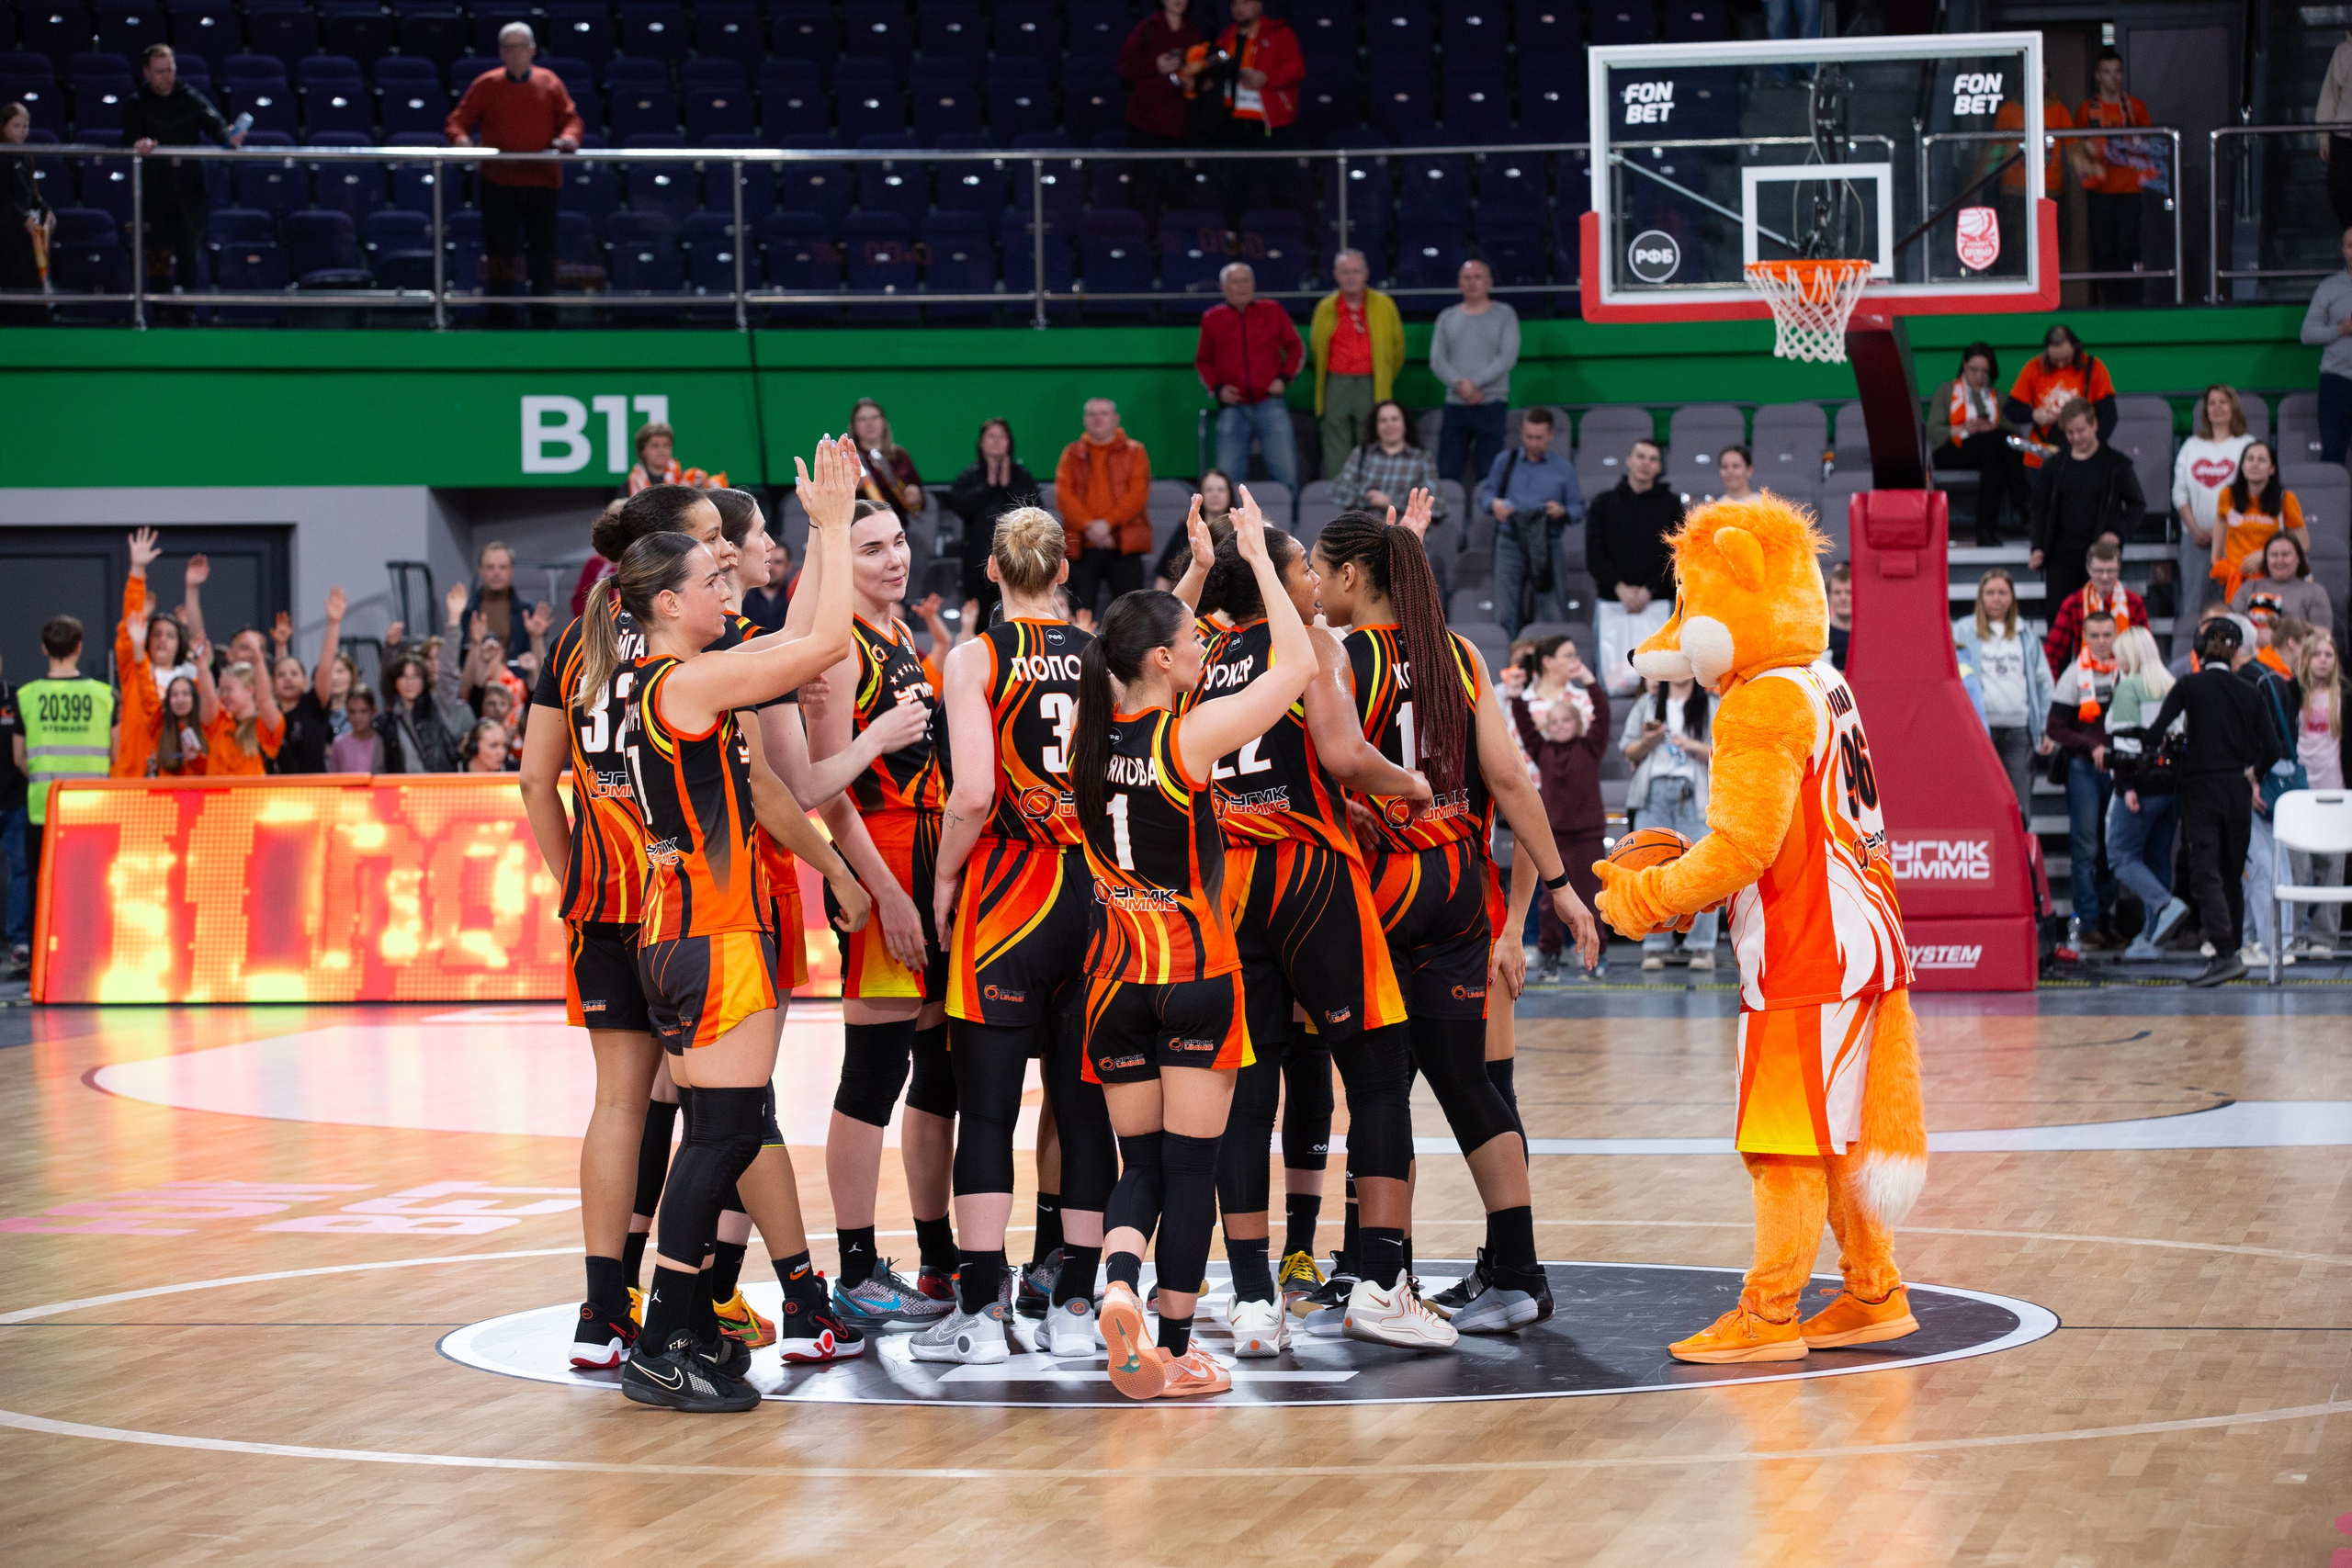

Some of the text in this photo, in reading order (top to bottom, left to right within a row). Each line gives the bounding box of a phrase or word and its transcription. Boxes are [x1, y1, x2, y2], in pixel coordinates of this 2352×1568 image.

[1624, 81, 1674, 104] FON
[1953, 73, 2003, 94] FON
[1625, 102, 1675, 124] BET
[1953, 94, 2004, 116] BET
[1635, 249, 1674, 264] РФБ
[616, 628, 645, 660] ЙГА
[1011, 655, 1081, 682] ПОПО
[39, 693, 92, 721] 20399
[1040, 693, 1075, 773] 3
[597, 772, 630, 784] УГ
[1104, 754, 1160, 786] ЯКОВА
[1840, 723, 1878, 820] 96
[1229, 785, 1289, 806] УГМК
[1230, 800, 1290, 815] UMMC
[1106, 793, 1136, 871] 1
[1891, 840, 1989, 861] УГМК
[1893, 860, 1990, 879] UMMC
[1113, 886, 1180, 904] УГМК
[1114, 898, 1180, 912] UMMC
